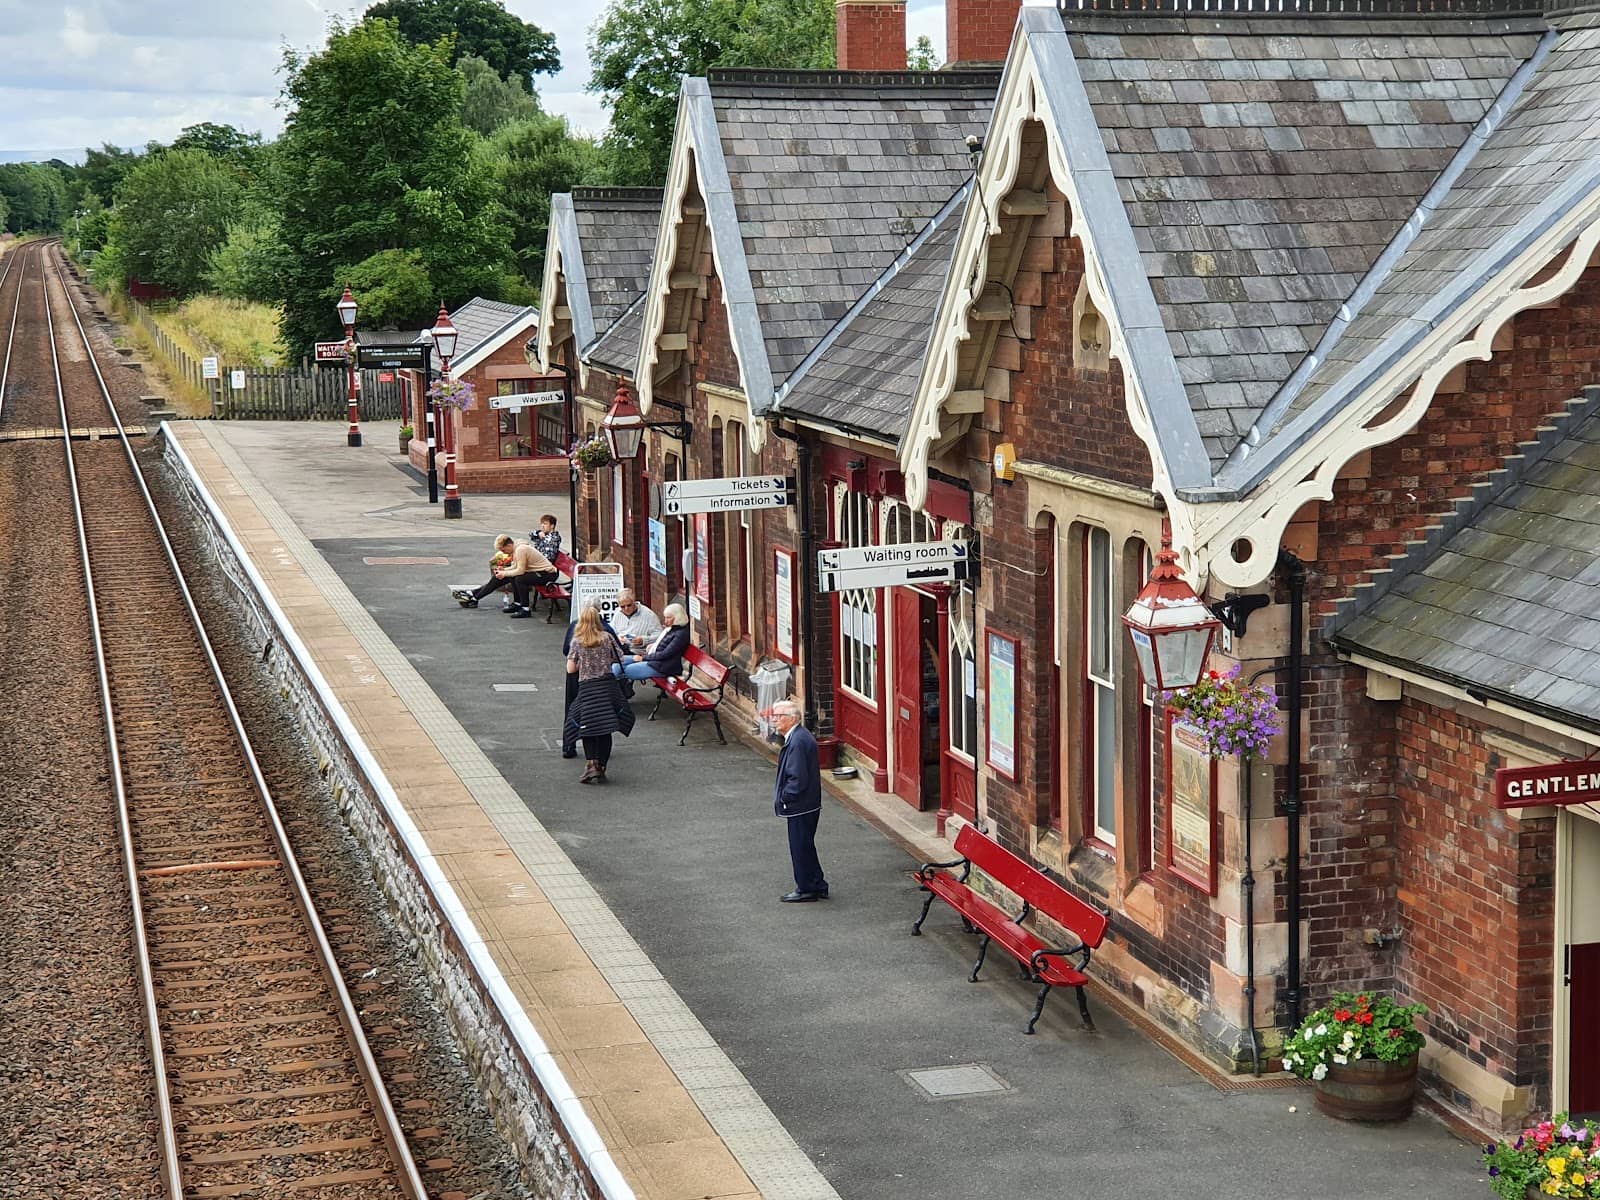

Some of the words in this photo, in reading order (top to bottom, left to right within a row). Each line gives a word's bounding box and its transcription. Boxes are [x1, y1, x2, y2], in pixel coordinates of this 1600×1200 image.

[521, 396, 538, 404] Way
[731, 479, 770, 490] Tickets
[710, 496, 770, 508] Information
[864, 548, 912, 562] Waiting
[916, 546, 948, 558] room
[1507, 773, 1600, 798] GENTLEM
